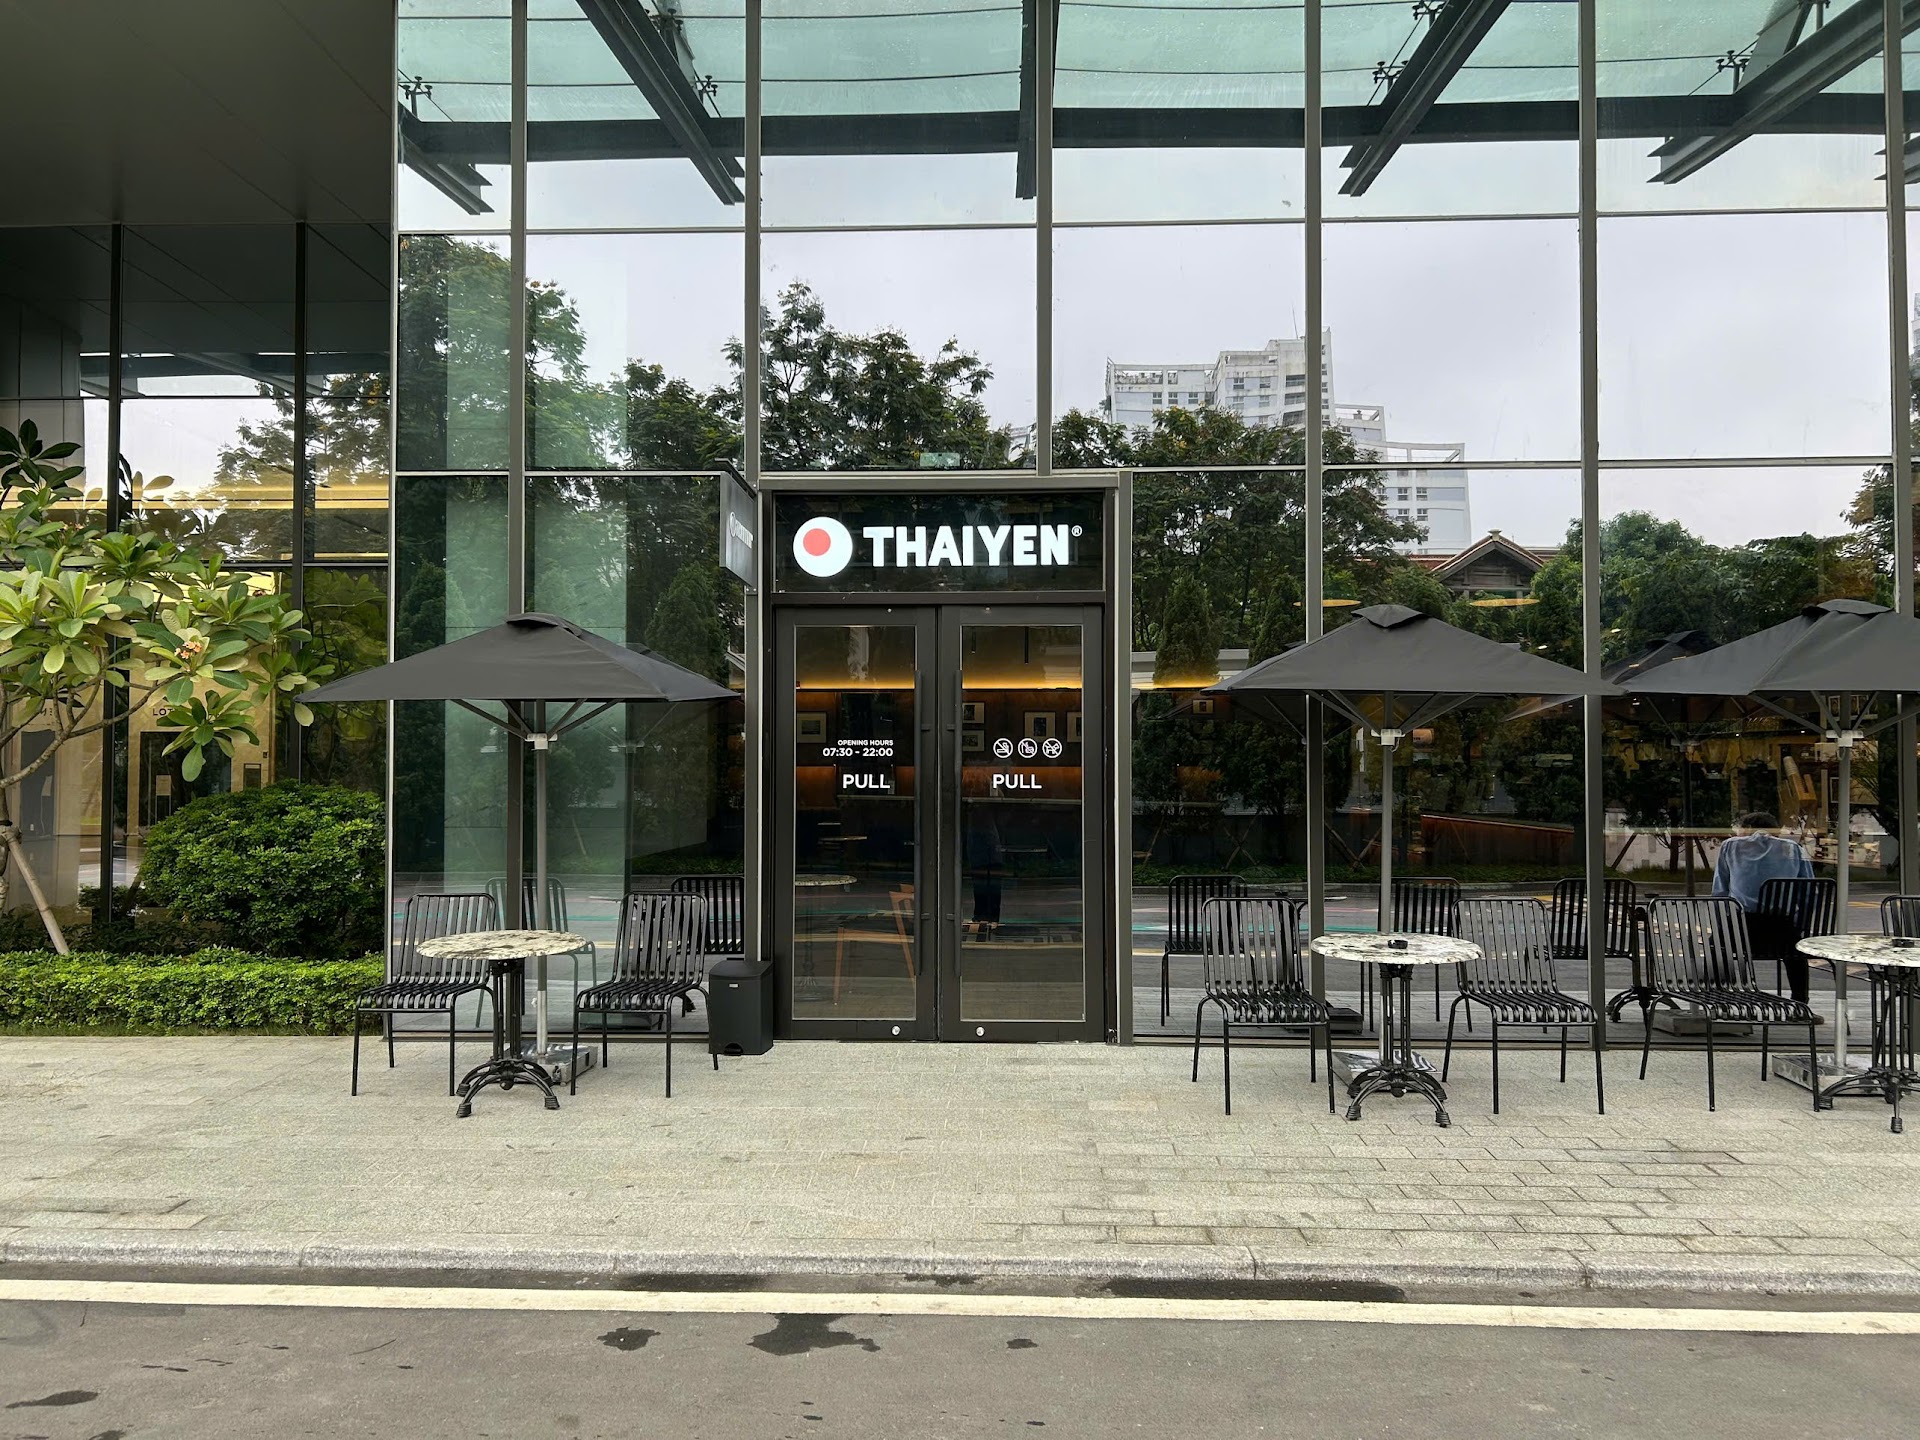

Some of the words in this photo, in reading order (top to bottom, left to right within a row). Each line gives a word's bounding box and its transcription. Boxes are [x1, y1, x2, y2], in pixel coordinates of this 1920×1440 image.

[822, 747, 853, 757] 07:30
[862, 747, 894, 757] 22:00
[842, 773, 891, 789] PULL
[992, 773, 1042, 789] PULL
